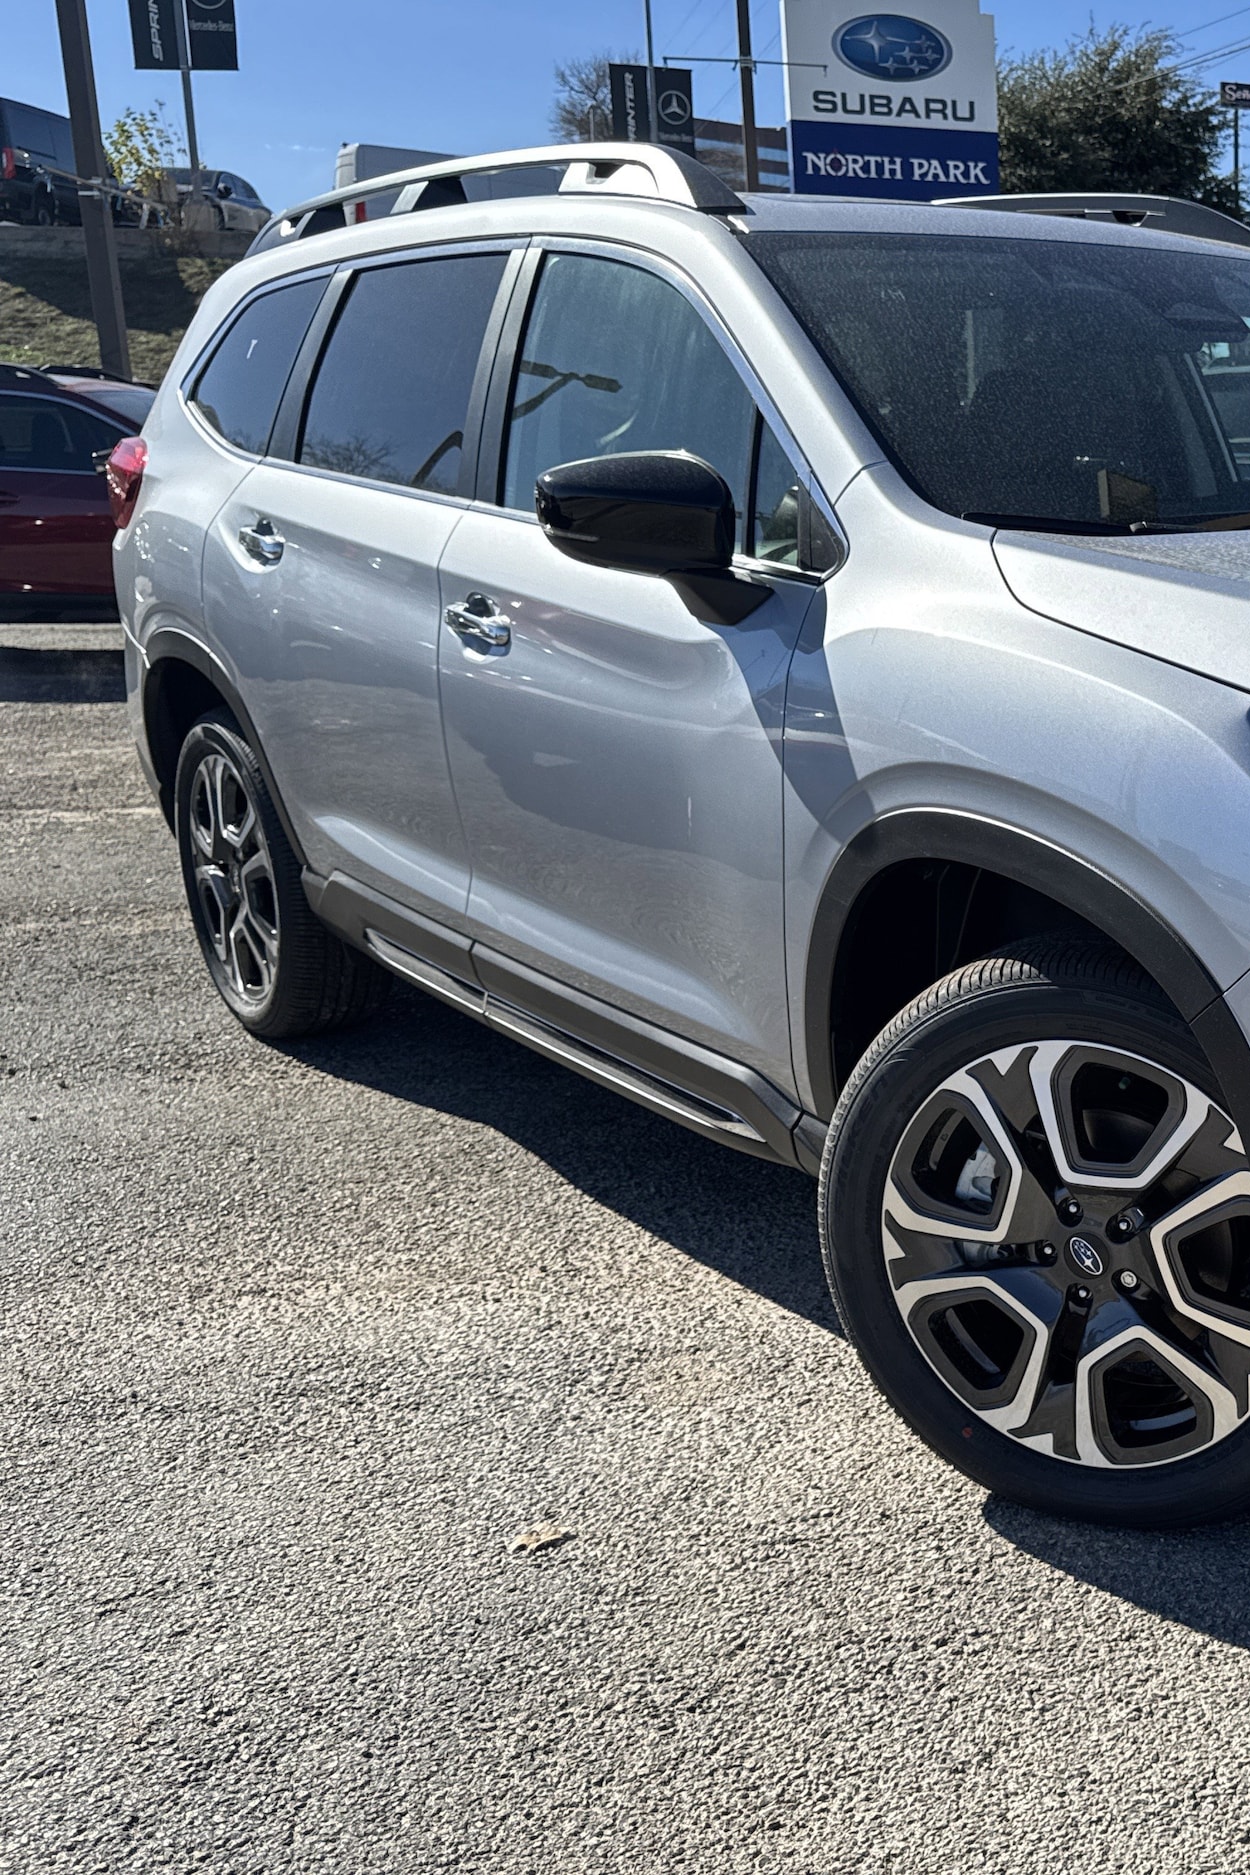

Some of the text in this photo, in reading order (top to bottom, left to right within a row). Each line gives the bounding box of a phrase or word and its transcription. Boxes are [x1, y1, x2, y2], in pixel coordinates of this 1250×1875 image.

[812, 90, 976, 123] SUBARU
[802, 150, 991, 185] NORTH PARK
